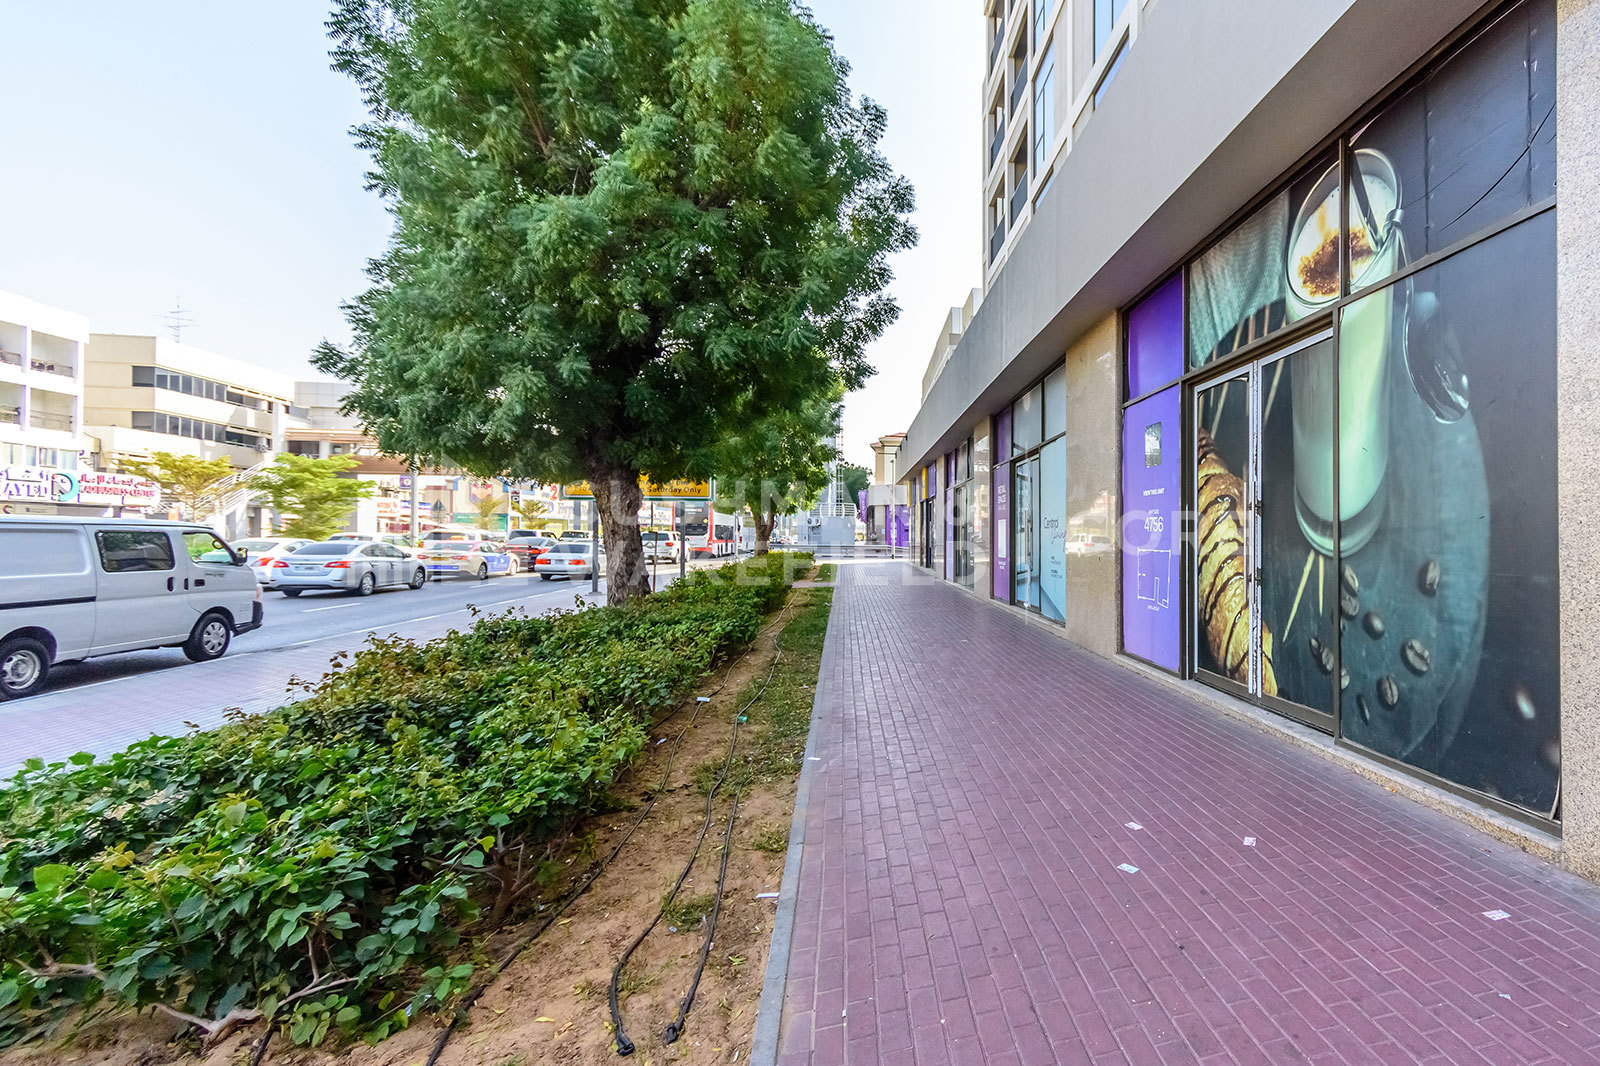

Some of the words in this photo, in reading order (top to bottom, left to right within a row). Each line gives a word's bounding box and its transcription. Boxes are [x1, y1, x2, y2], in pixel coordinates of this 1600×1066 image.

[646, 486, 682, 494] Saturday
[683, 486, 702, 494] Only
[1143, 515, 1164, 533] 4756
